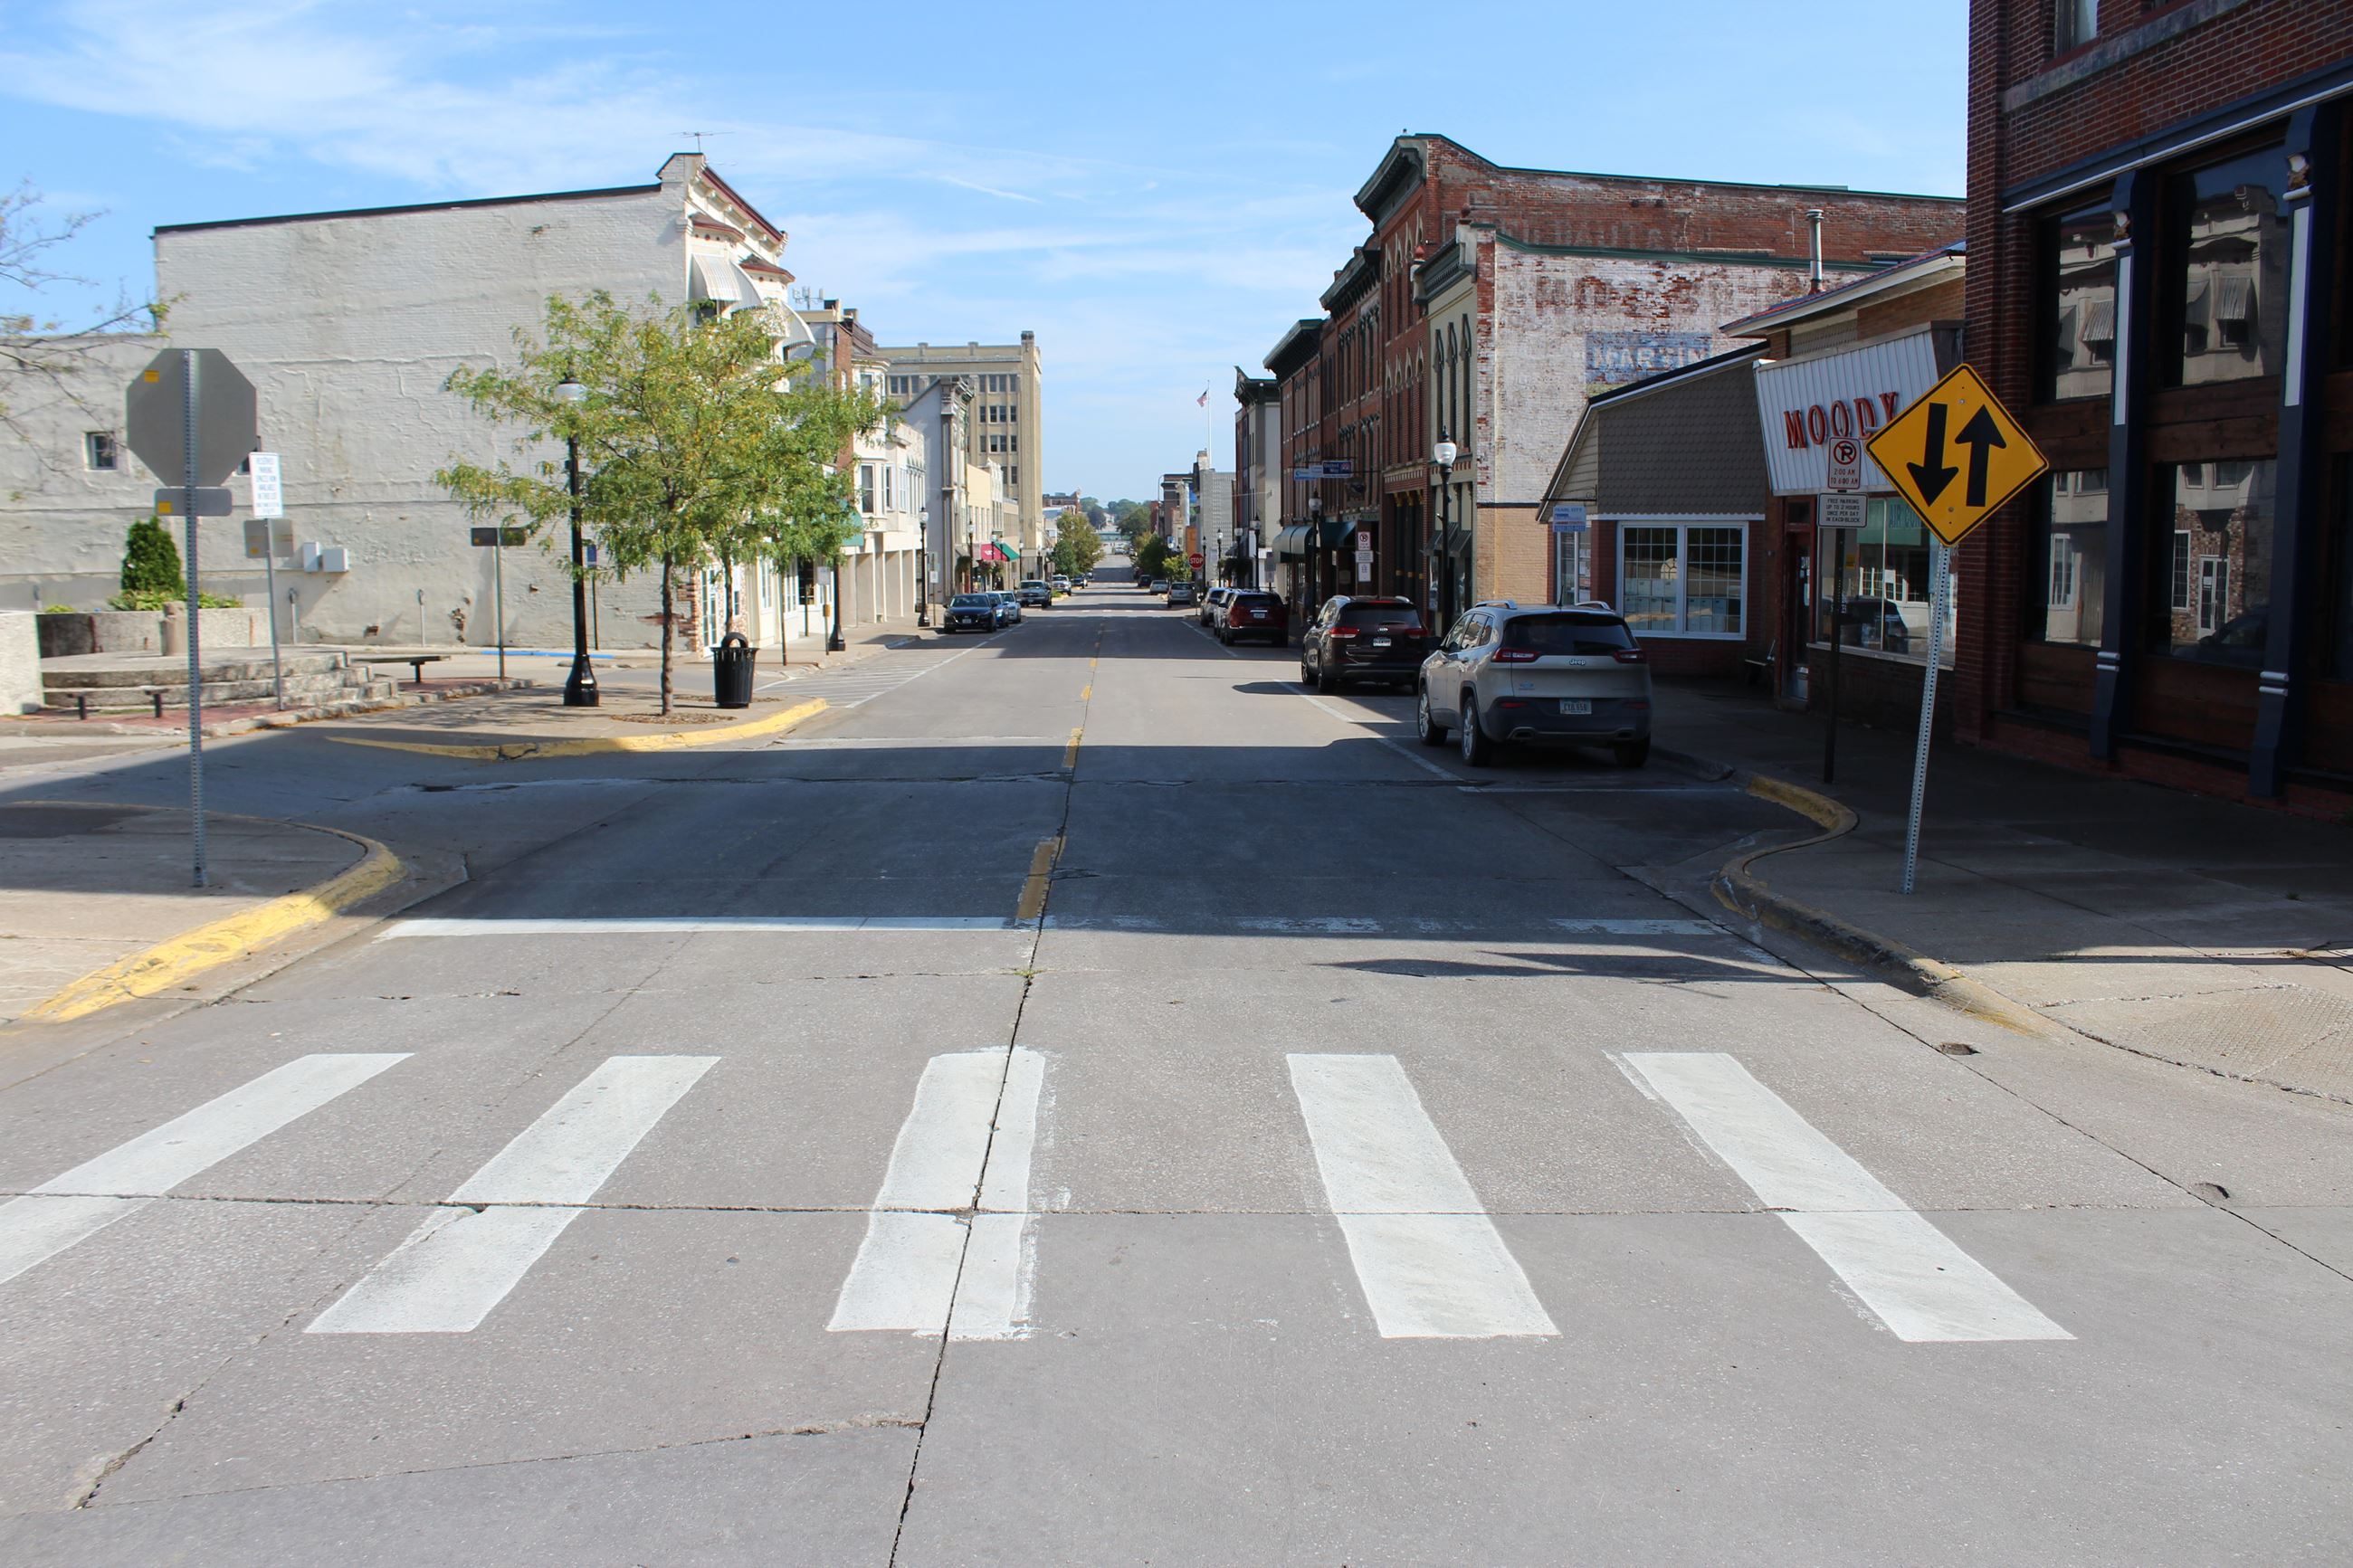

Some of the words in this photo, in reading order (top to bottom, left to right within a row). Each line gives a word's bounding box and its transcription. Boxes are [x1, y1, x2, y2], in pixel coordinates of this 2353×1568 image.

[1783, 391, 1899, 450] MOODY
[1834, 468, 1846, 476] 2:00
[1830, 477, 1837, 485] TO
[1838, 477, 1849, 485] 6:00
[1851, 477, 1858, 485] AM
[1569, 659, 1586, 667] Jeep
